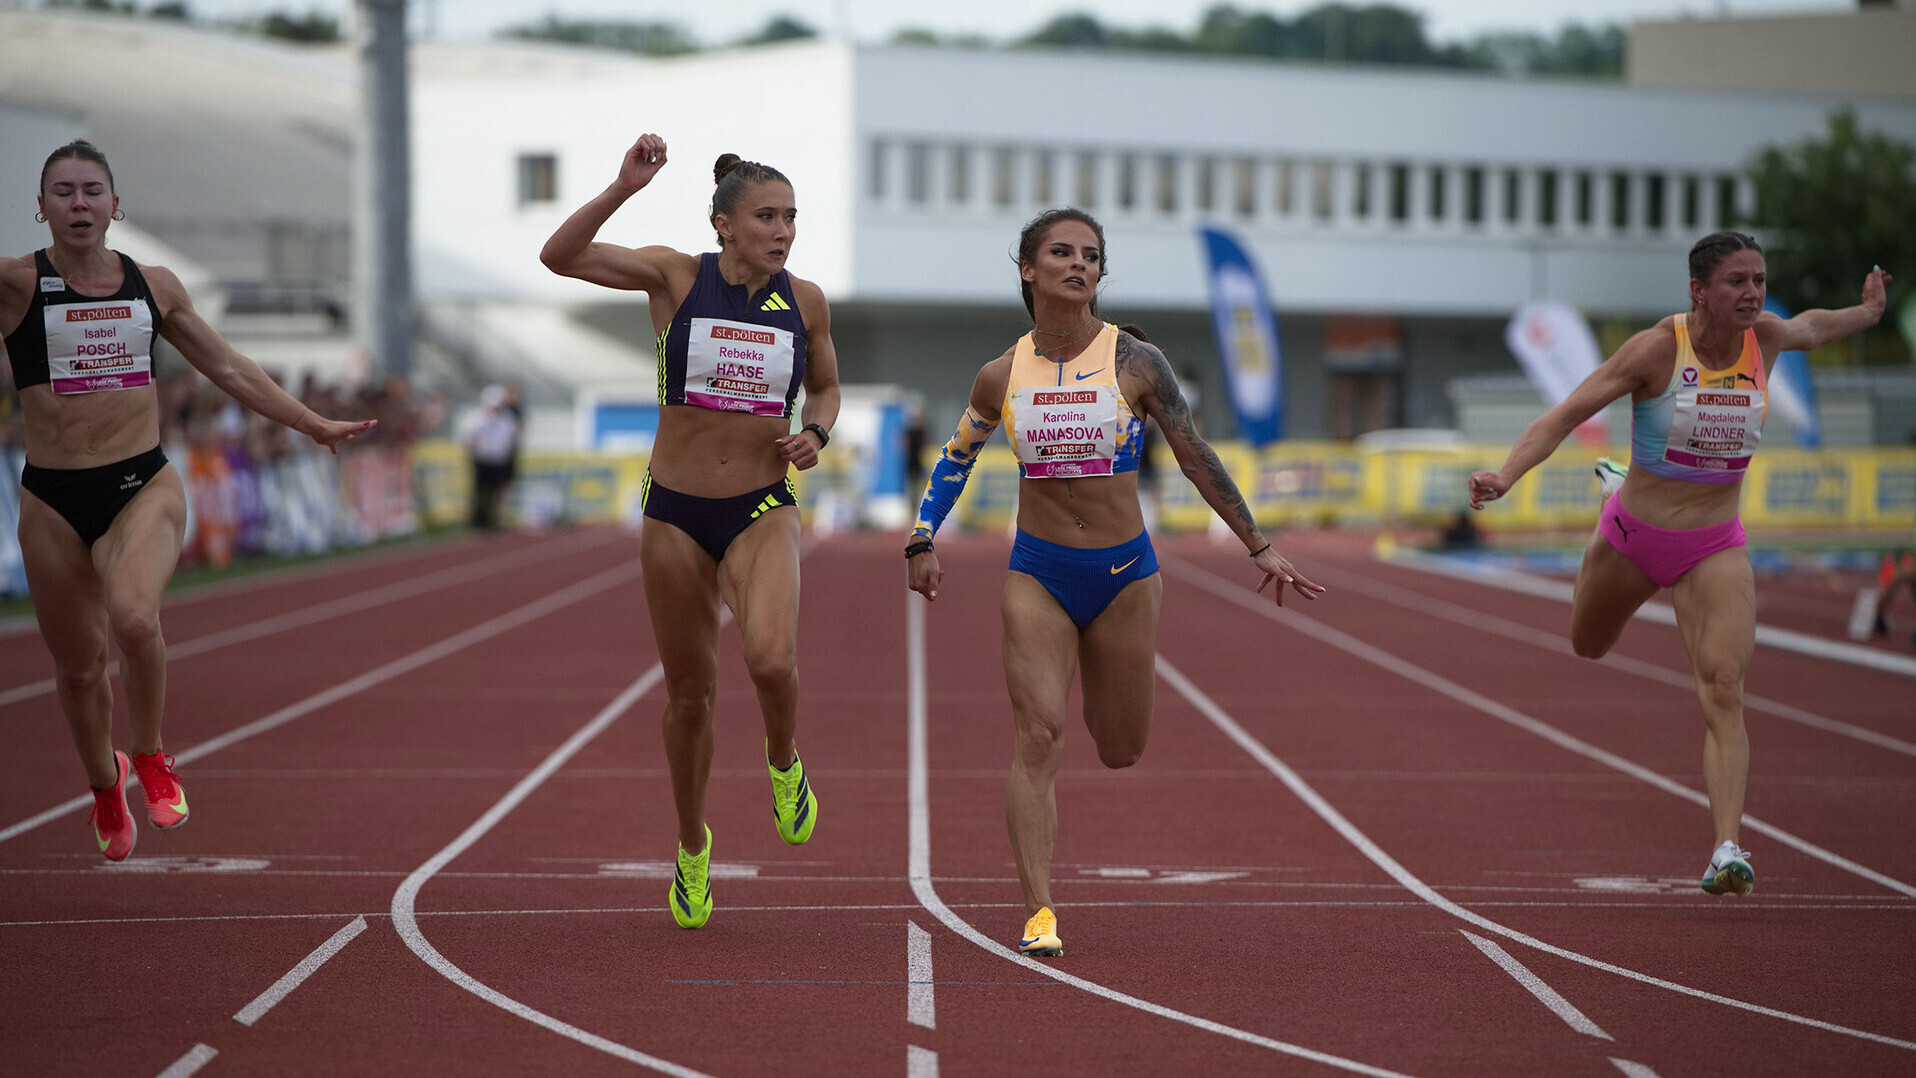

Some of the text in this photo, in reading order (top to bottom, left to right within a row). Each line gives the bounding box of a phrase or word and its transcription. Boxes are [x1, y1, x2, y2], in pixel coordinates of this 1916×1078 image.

[71, 308, 127, 321] st.pölten
[84, 327, 116, 339] Isabel
[716, 328, 771, 342] st.pölten
[77, 342, 127, 356] POSCH
[719, 346, 765, 361] Rebekka
[80, 356, 132, 369] TRANSFER
[716, 362, 766, 380] HAASE
[718, 380, 767, 393] TRANSFER
[1038, 392, 1092, 405] st.pölten
[1043, 411, 1086, 423] Karolina
[1697, 412, 1746, 423] Magdalena
[1027, 426, 1104, 442] MANASOVA
[1692, 426, 1746, 439] LINDNER
